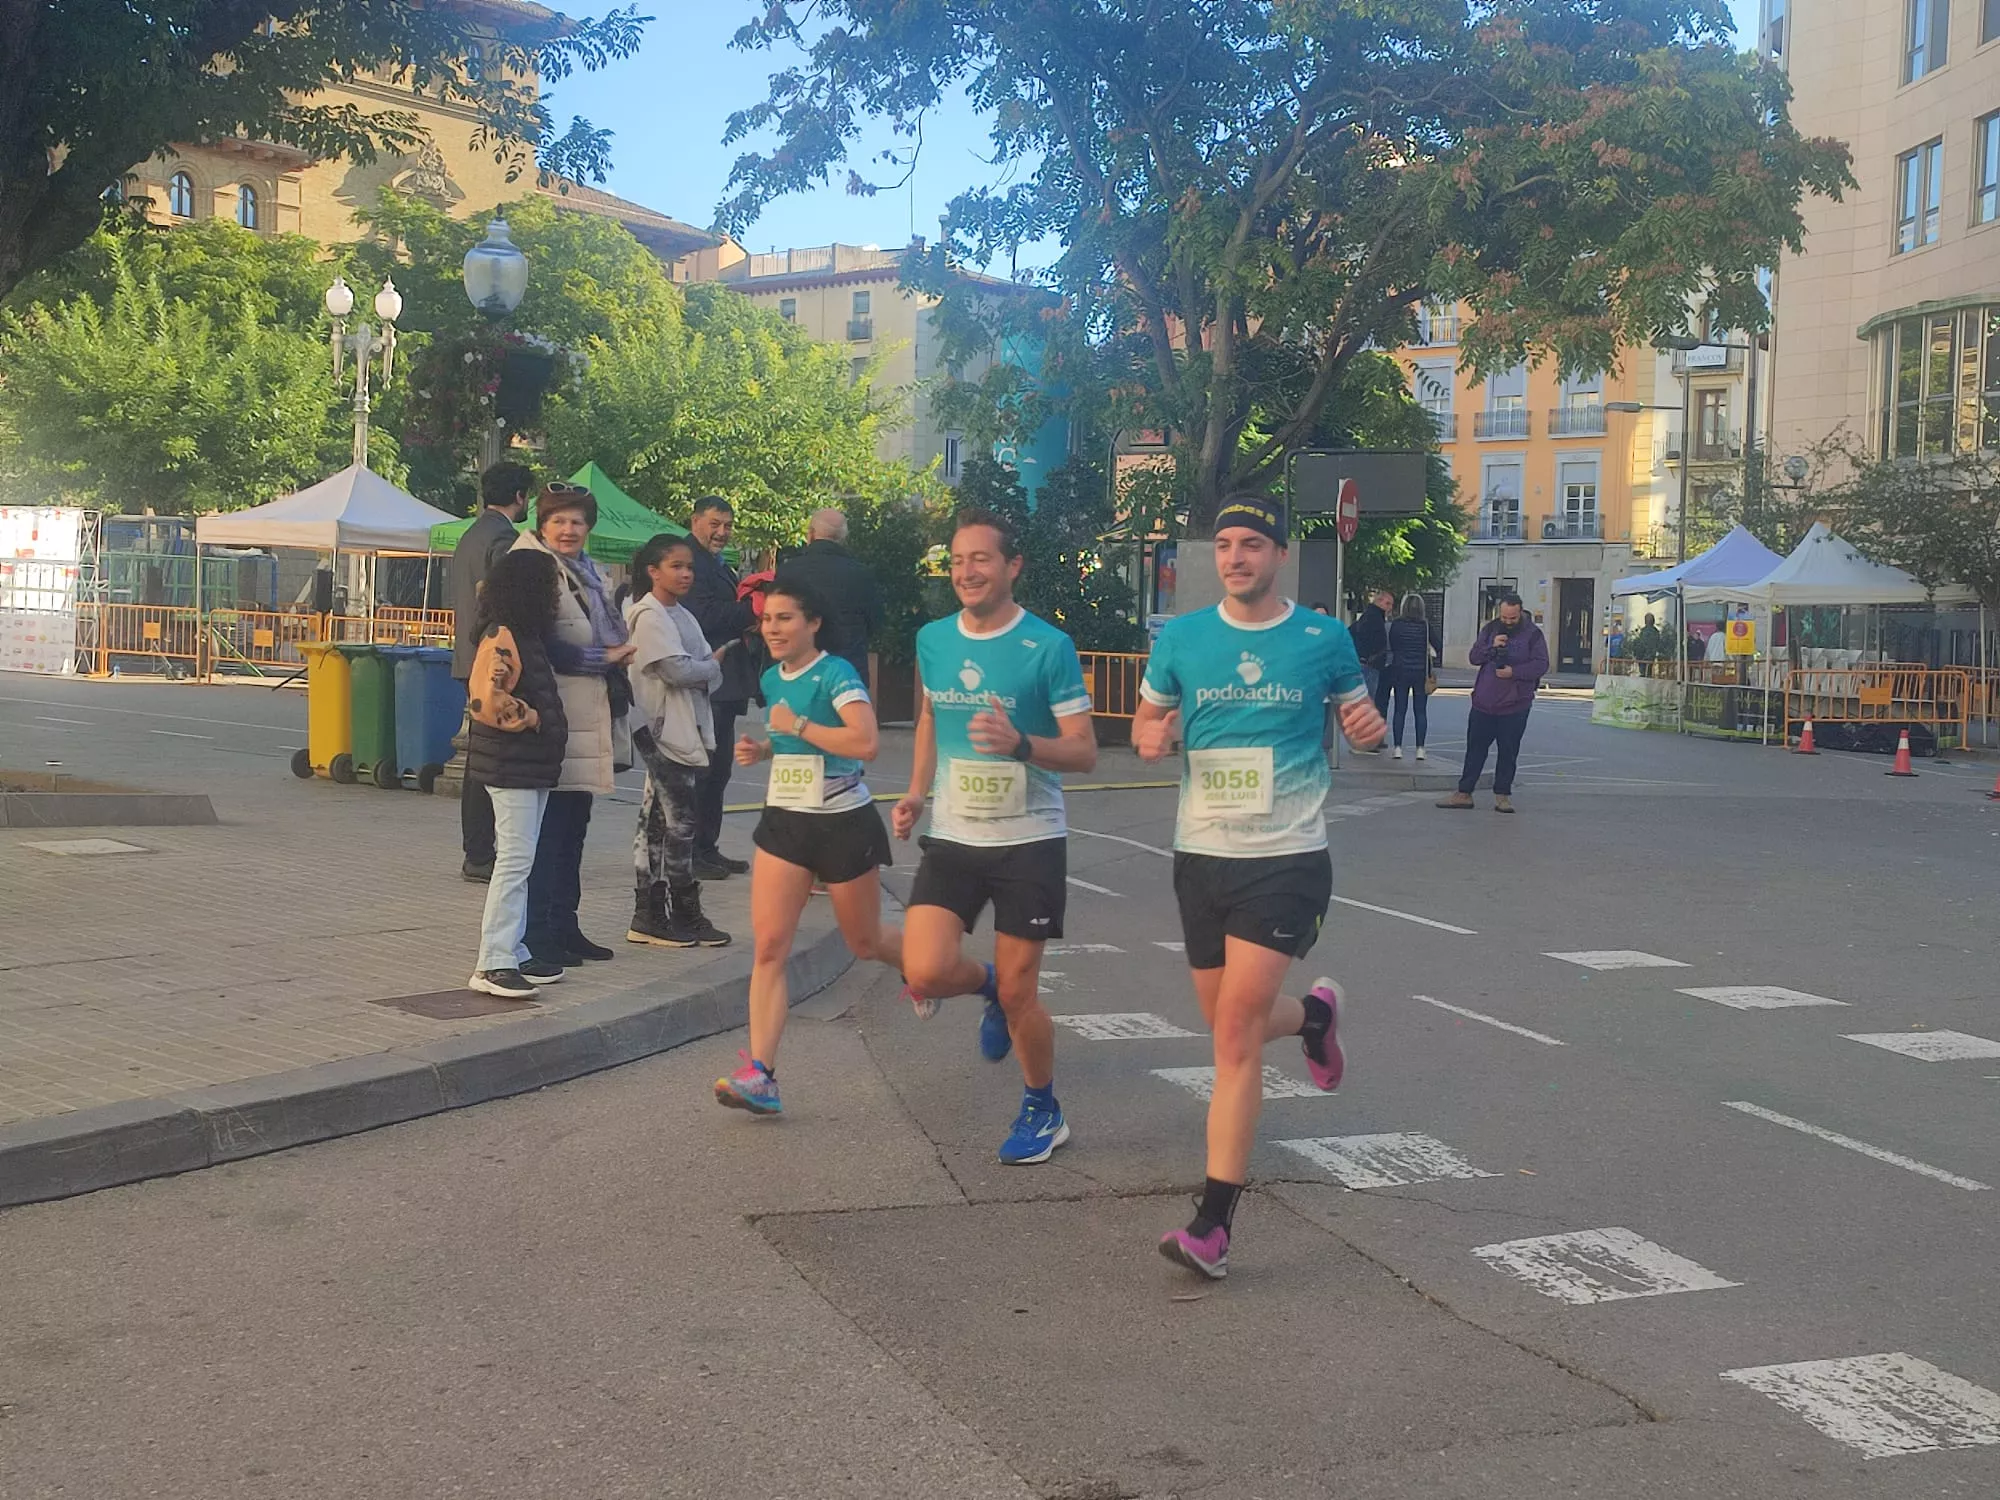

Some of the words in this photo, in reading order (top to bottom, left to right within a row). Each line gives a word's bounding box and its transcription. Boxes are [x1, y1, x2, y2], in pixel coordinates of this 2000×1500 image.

[1196, 682, 1303, 709] podoactiva
[773, 768, 813, 784] 3059
[960, 775, 1014, 793] 3057
[1201, 769, 1260, 790] 3058
